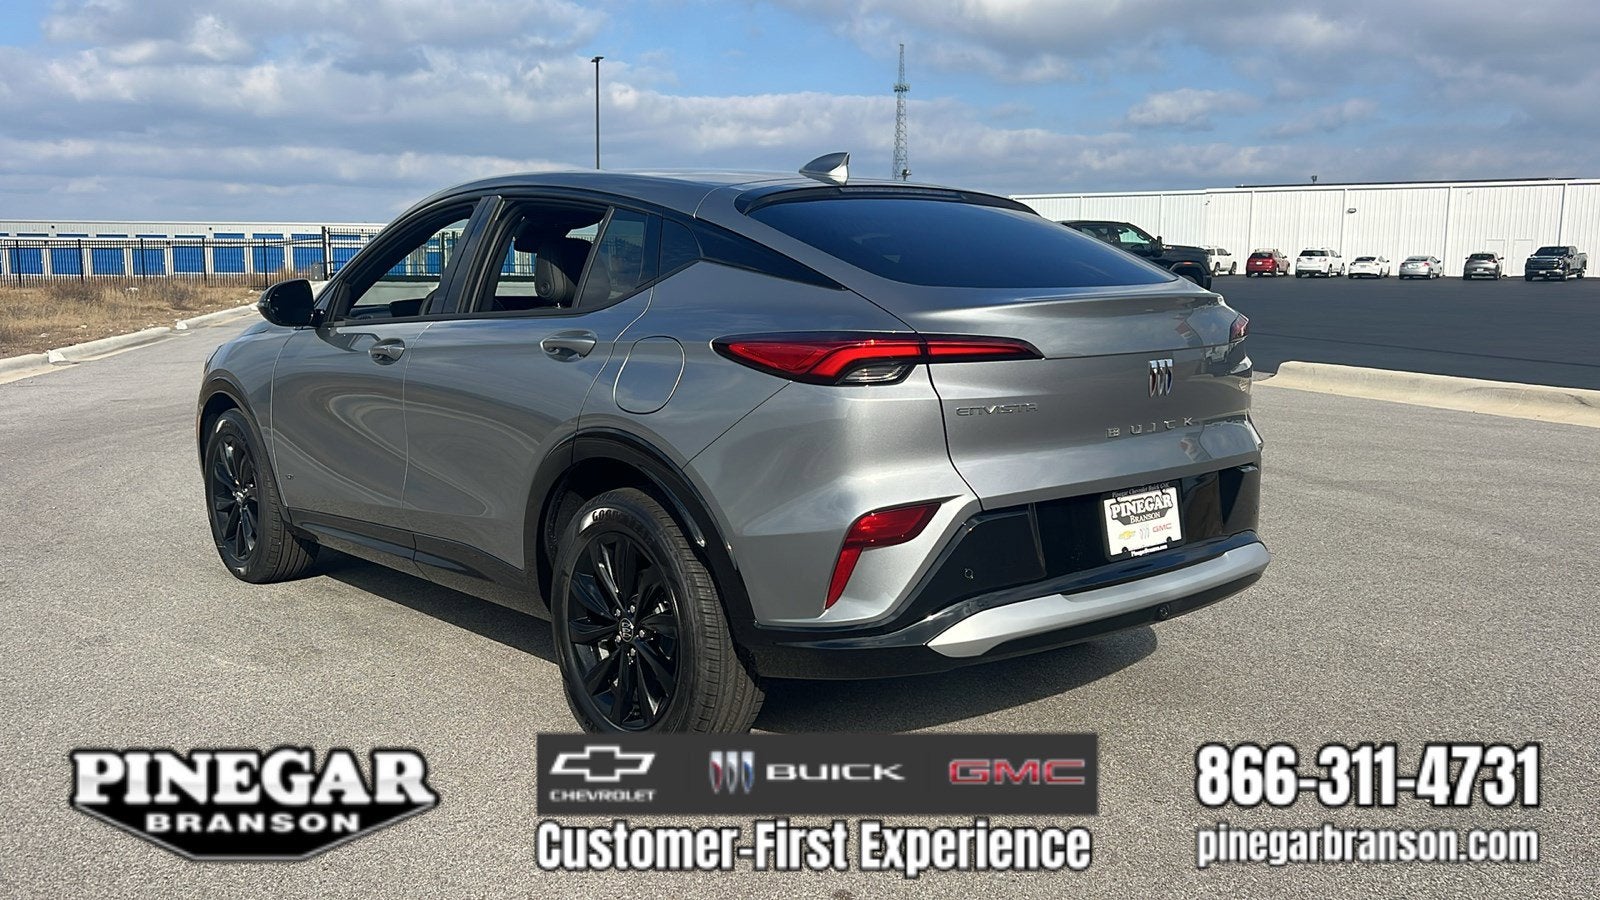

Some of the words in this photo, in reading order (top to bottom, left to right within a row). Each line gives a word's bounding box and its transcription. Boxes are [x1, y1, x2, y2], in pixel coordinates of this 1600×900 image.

[956, 403, 1038, 417] ENVISTA
[1106, 417, 1194, 438] BUICK
[1110, 494, 1173, 519] PINEGAR
[1152, 523, 1172, 533] GMC
